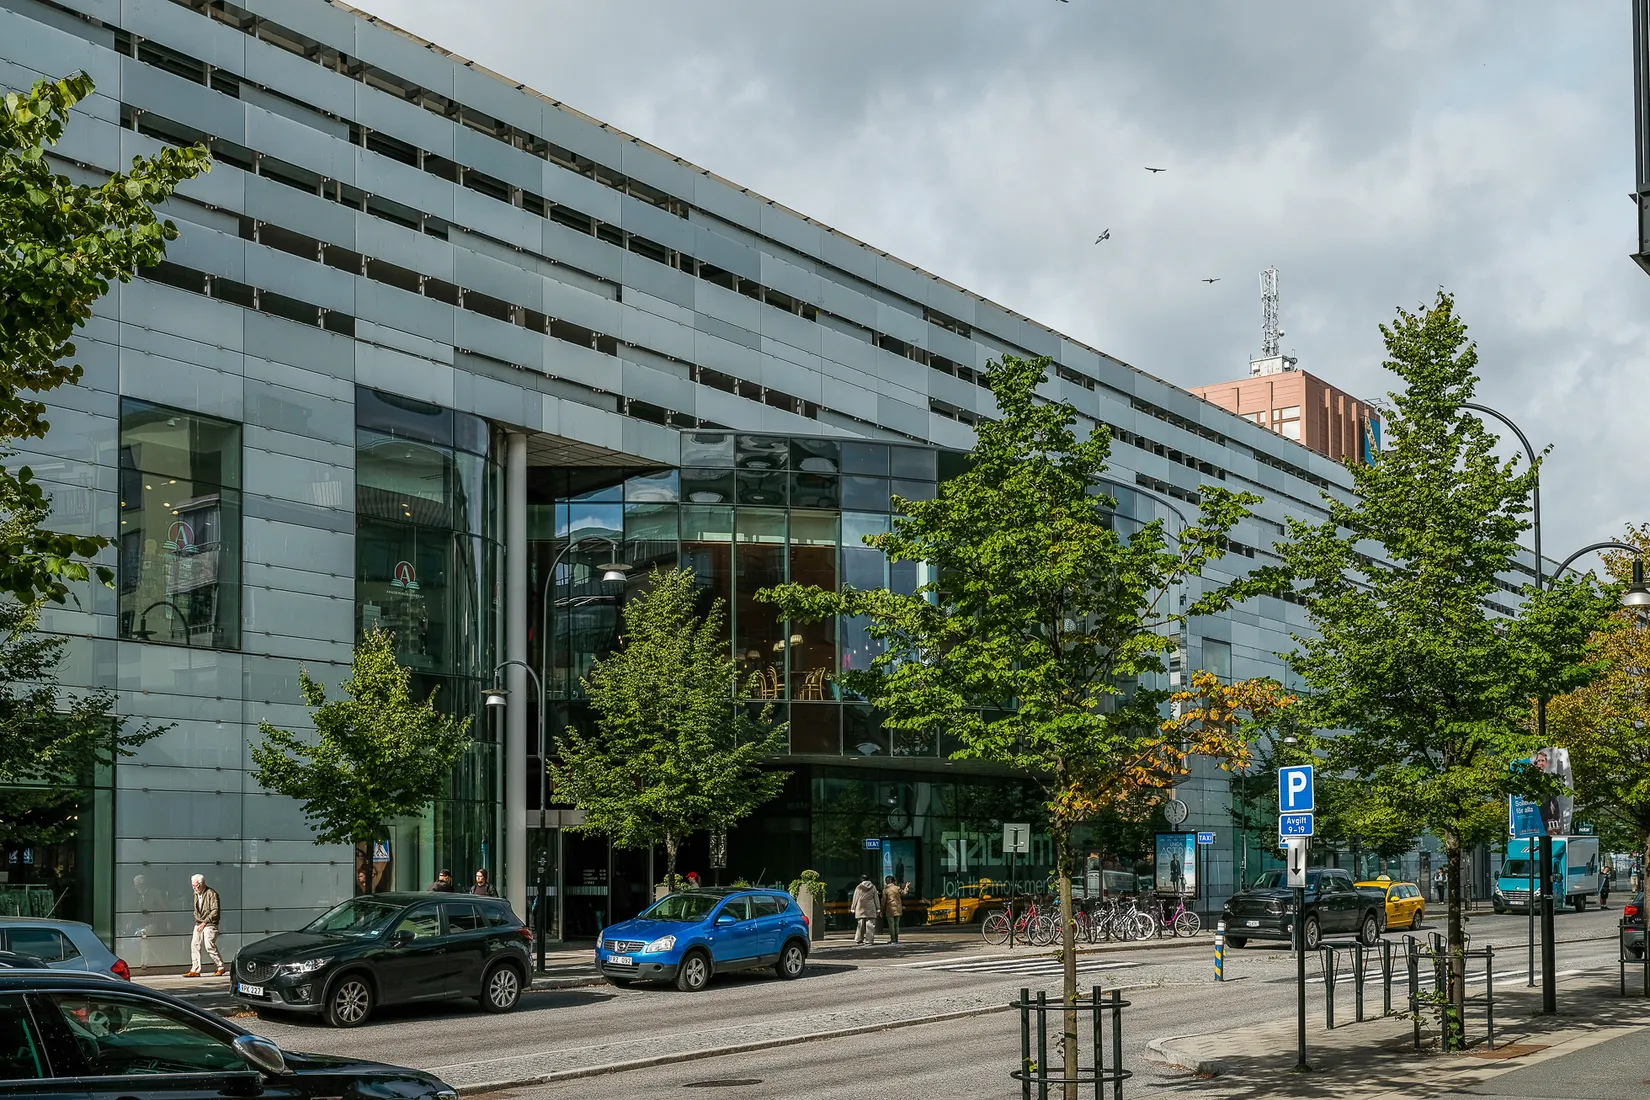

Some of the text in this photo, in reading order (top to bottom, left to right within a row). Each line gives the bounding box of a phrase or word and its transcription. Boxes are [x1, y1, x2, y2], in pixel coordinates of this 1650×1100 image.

[1287, 771, 1307, 807] P
[1286, 817, 1307, 826] Avgift
[941, 876, 965, 897] Join
[992, 879, 1050, 895] movemen
